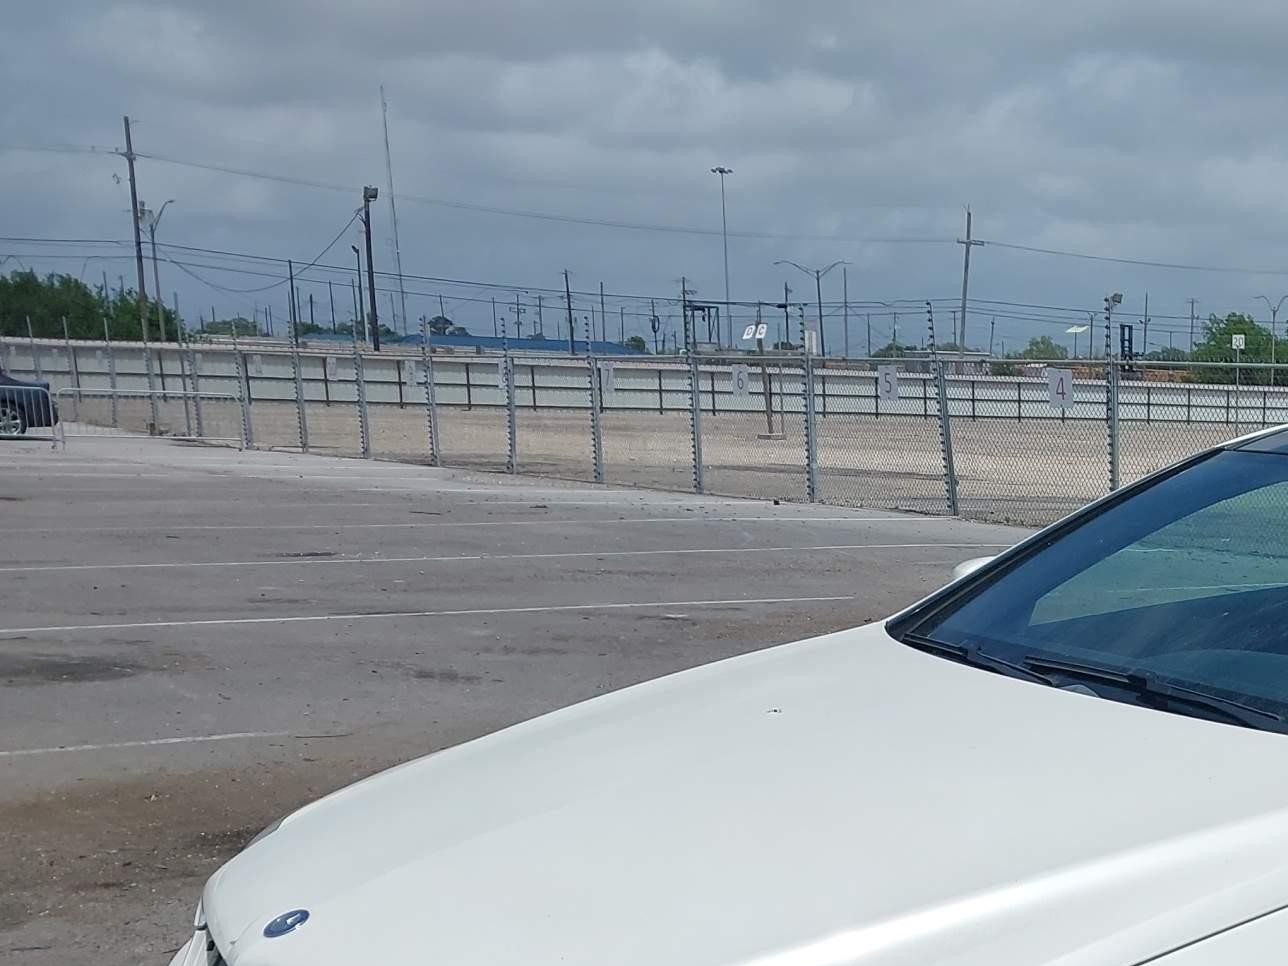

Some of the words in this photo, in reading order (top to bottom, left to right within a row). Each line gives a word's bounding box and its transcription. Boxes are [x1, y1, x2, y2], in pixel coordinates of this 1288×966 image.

[737, 370, 744, 390] 6
[884, 372, 893, 393] 5
[1055, 377, 1066, 400] 4
